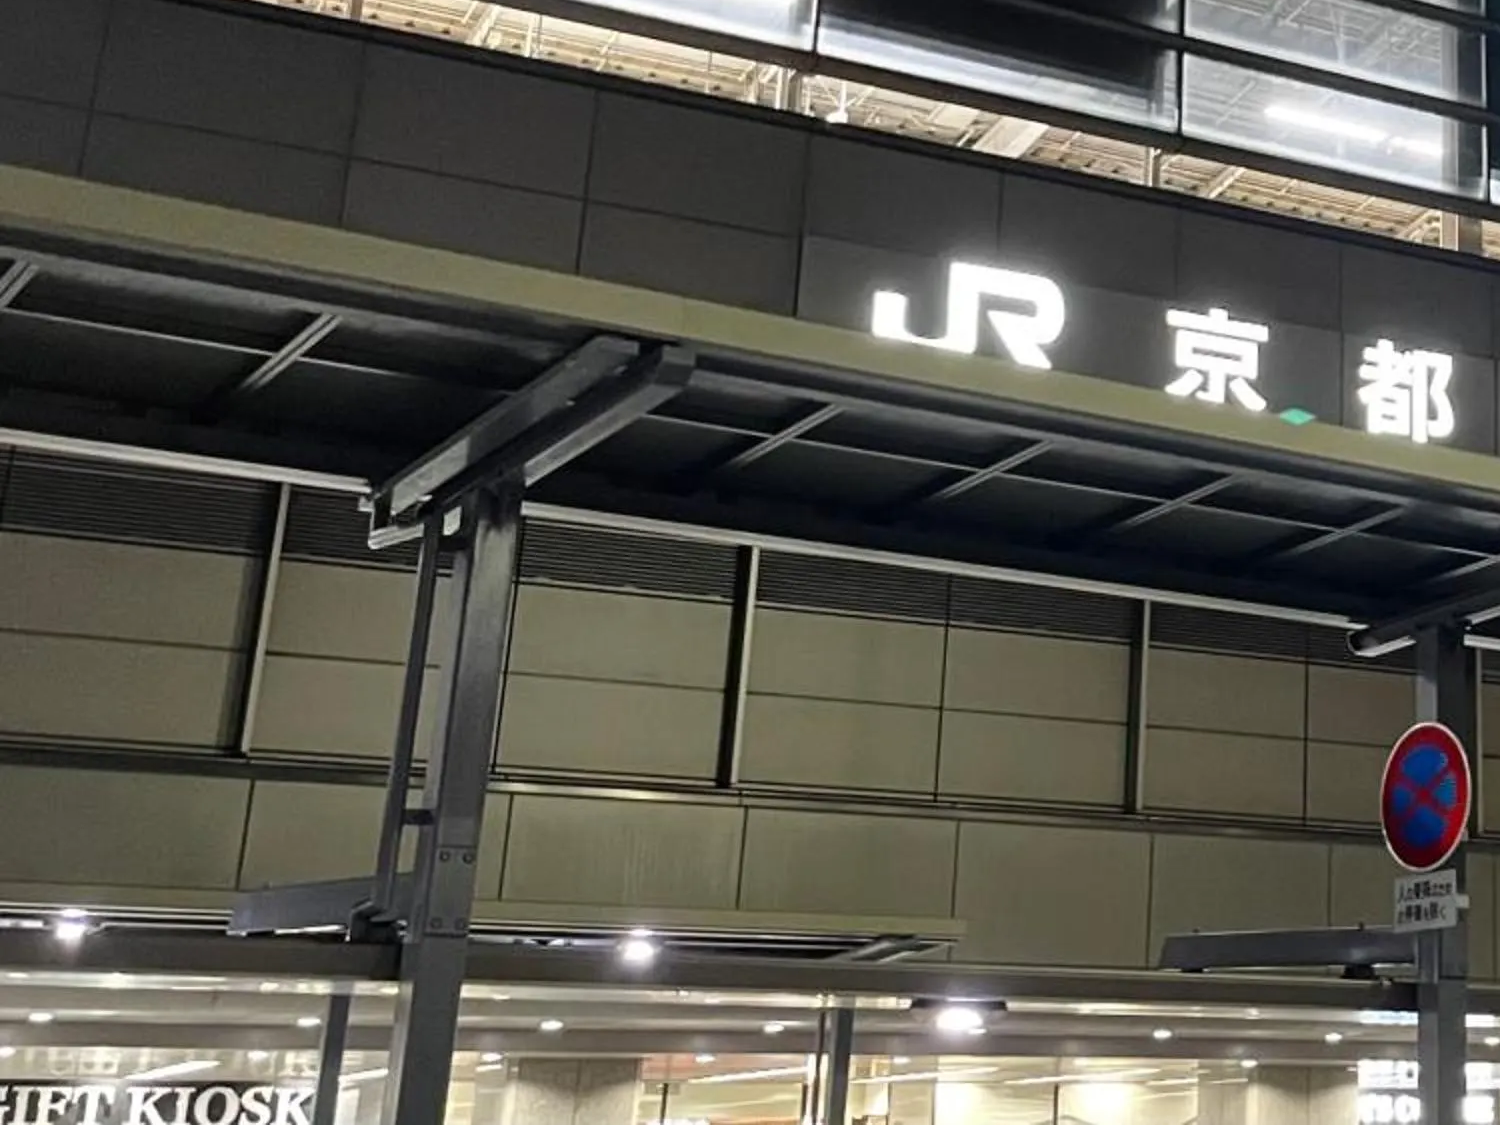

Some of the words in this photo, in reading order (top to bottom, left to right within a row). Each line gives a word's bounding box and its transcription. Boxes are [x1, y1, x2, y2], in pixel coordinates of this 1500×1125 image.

[869, 260, 1067, 372] JR
[0, 1085, 116, 1125] IFT
[121, 1085, 317, 1125] KIOSK
